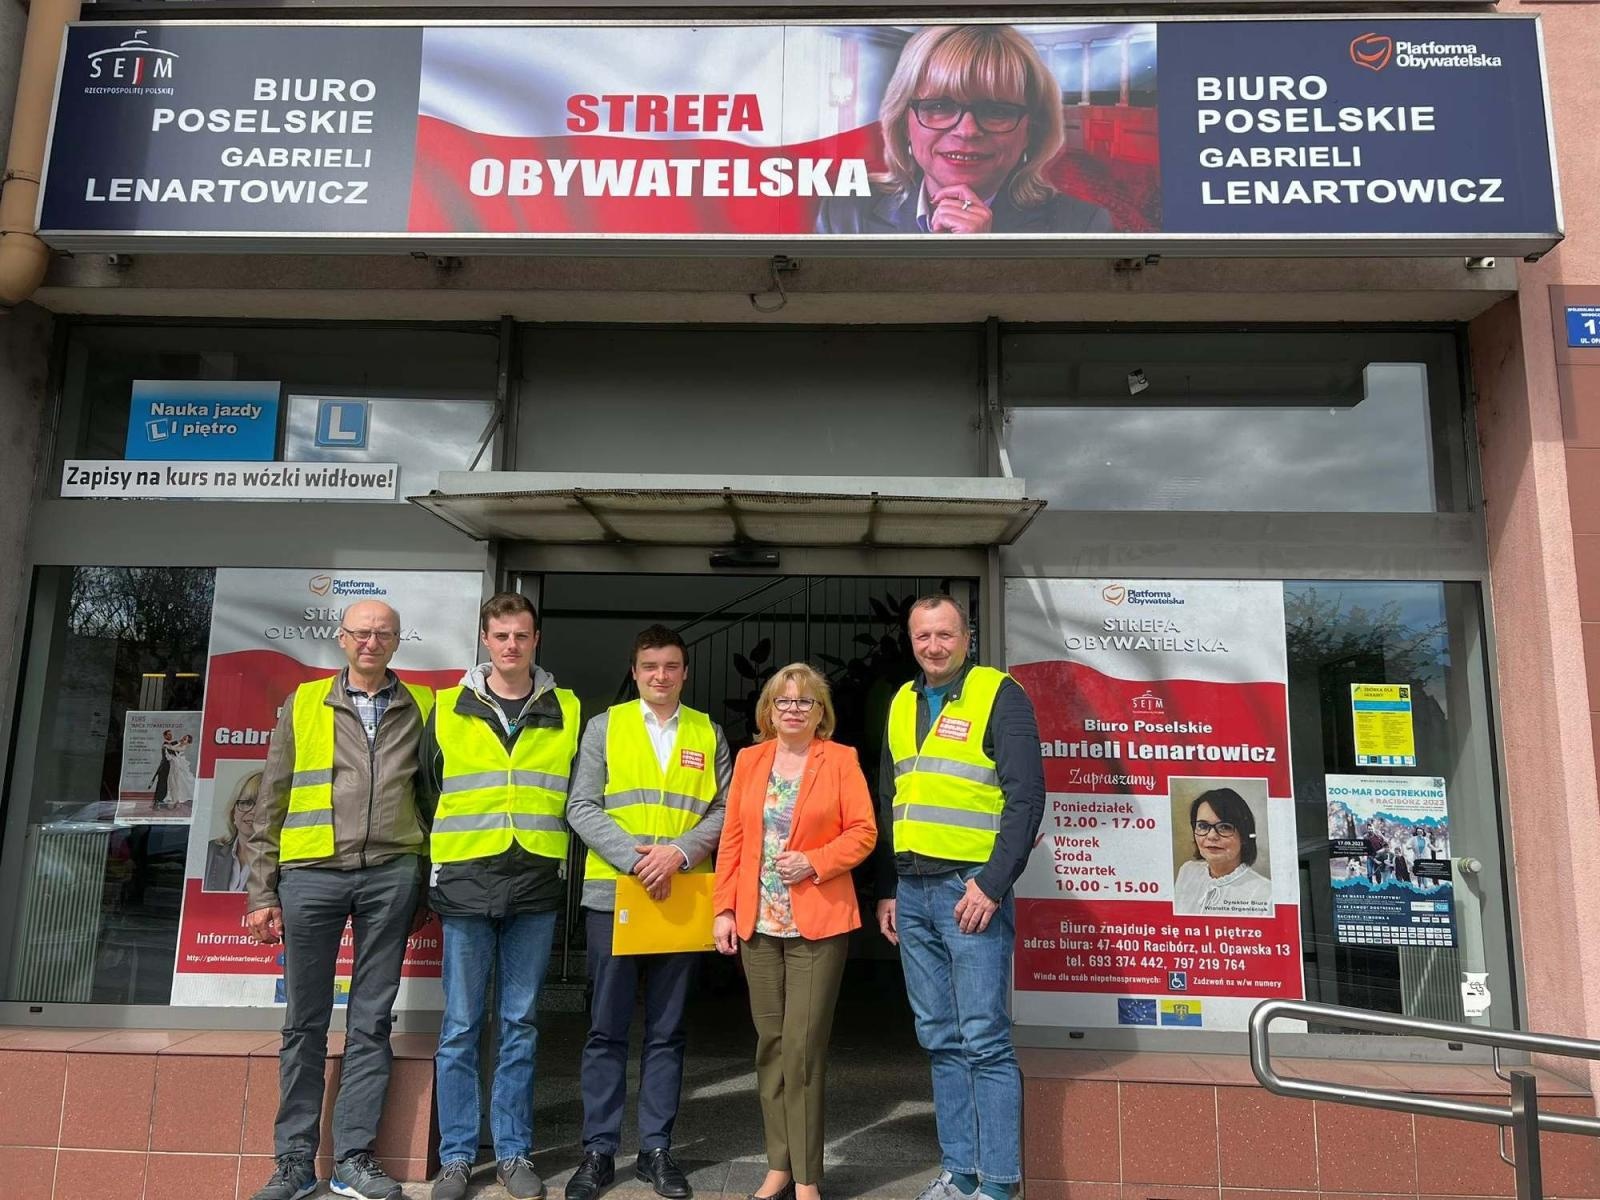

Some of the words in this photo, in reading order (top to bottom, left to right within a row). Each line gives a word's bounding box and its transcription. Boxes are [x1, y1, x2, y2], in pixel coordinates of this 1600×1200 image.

[1396, 41, 1477, 54] Platforma
[1396, 54, 1502, 69] Obywatelska
[89, 57, 172, 85] SEJM
[253, 78, 376, 102] BIURO
[1197, 76, 1328, 101] BIURO
[151, 108, 373, 134] POSELSKIE
[566, 94, 764, 132] STREFA
[1198, 106, 1436, 134] POSELSKIE
[221, 147, 372, 168] GABRIELI
[1200, 146, 1361, 168] GABRIELI
[469, 158, 872, 196] OBYWATELSKA
[85, 178, 368, 204] LENARTOWICZ
[1202, 178, 1504, 204] LENARTOWICZ
[151, 402, 208, 416] Nauka
[213, 403, 262, 420] jazdy
[183, 420, 237, 436] piętro
[328, 406, 356, 440] L
[66, 466, 132, 490] Zapisy
[137, 470, 160, 486] na
[166, 467, 208, 486] kurs
[214, 473, 236, 486] na
[243, 467, 300, 488] wózki
[305, 469, 394, 488] widłowe!
[332, 580, 375, 588] Platforma
[332, 587, 386, 596] Obywatelska
[1128, 590, 1172, 598] Platforma
[1128, 597, 1184, 606] Obywatelska
[1104, 617, 1180, 632] STREFA
[1064, 636, 1228, 652] OBYWATELSKA
[1132, 700, 1164, 710] SEJM
[1084, 719, 1128, 732] Biuro
[1134, 720, 1212, 734] Poselskie
[1041, 740, 1120, 760] abrieli
[1128, 742, 1276, 762] Lenartowicz
[1068, 768, 1156, 790] Zapraszamy
[1328, 788, 1372, 796] ZOO-MAR
[1374, 788, 1444, 798] DOGTREKKING
[1053, 800, 1134, 814] Poniedziałek
[1054, 816, 1098, 828] 12.00
[1112, 818, 1156, 830] 17.00
[1054, 836, 1100, 848] Wtorek
[1054, 850, 1092, 862] Środa
[1054, 864, 1116, 876] Czwartek
[1056, 880, 1099, 892] 10.00
[1115, 880, 1159, 894] 15.00
[1060, 921, 1096, 934] Biuro
[1100, 922, 1156, 938] znajduje
[1160, 925, 1180, 938] się
[1184, 928, 1201, 937] na
[1215, 928, 1262, 940] piętrze
[1024, 938, 1056, 950] adres
[1059, 940, 1093, 951] biura:
[1096, 940, 1140, 952] 47-400
[1144, 942, 1198, 954] Racibórz,
[1202, 943, 1216, 954] ul.
[1220, 944, 1272, 957] Opawska
[1276, 944, 1290, 956] 13
[1066, 955, 1084, 967] tel.
[1089, 956, 1112, 967] 693
[1116, 956, 1136, 968] 374
[1140, 957, 1168, 970] 442,
[1174, 958, 1194, 970] 797
[1199, 958, 1220, 970] 219
[1224, 959, 1245, 971] 764
[1034, 972, 1056, 981] Winda
[1059, 973, 1070, 982] dla
[1072, 973, 1088, 982] osób
[1254, 979, 1282, 988] numery
